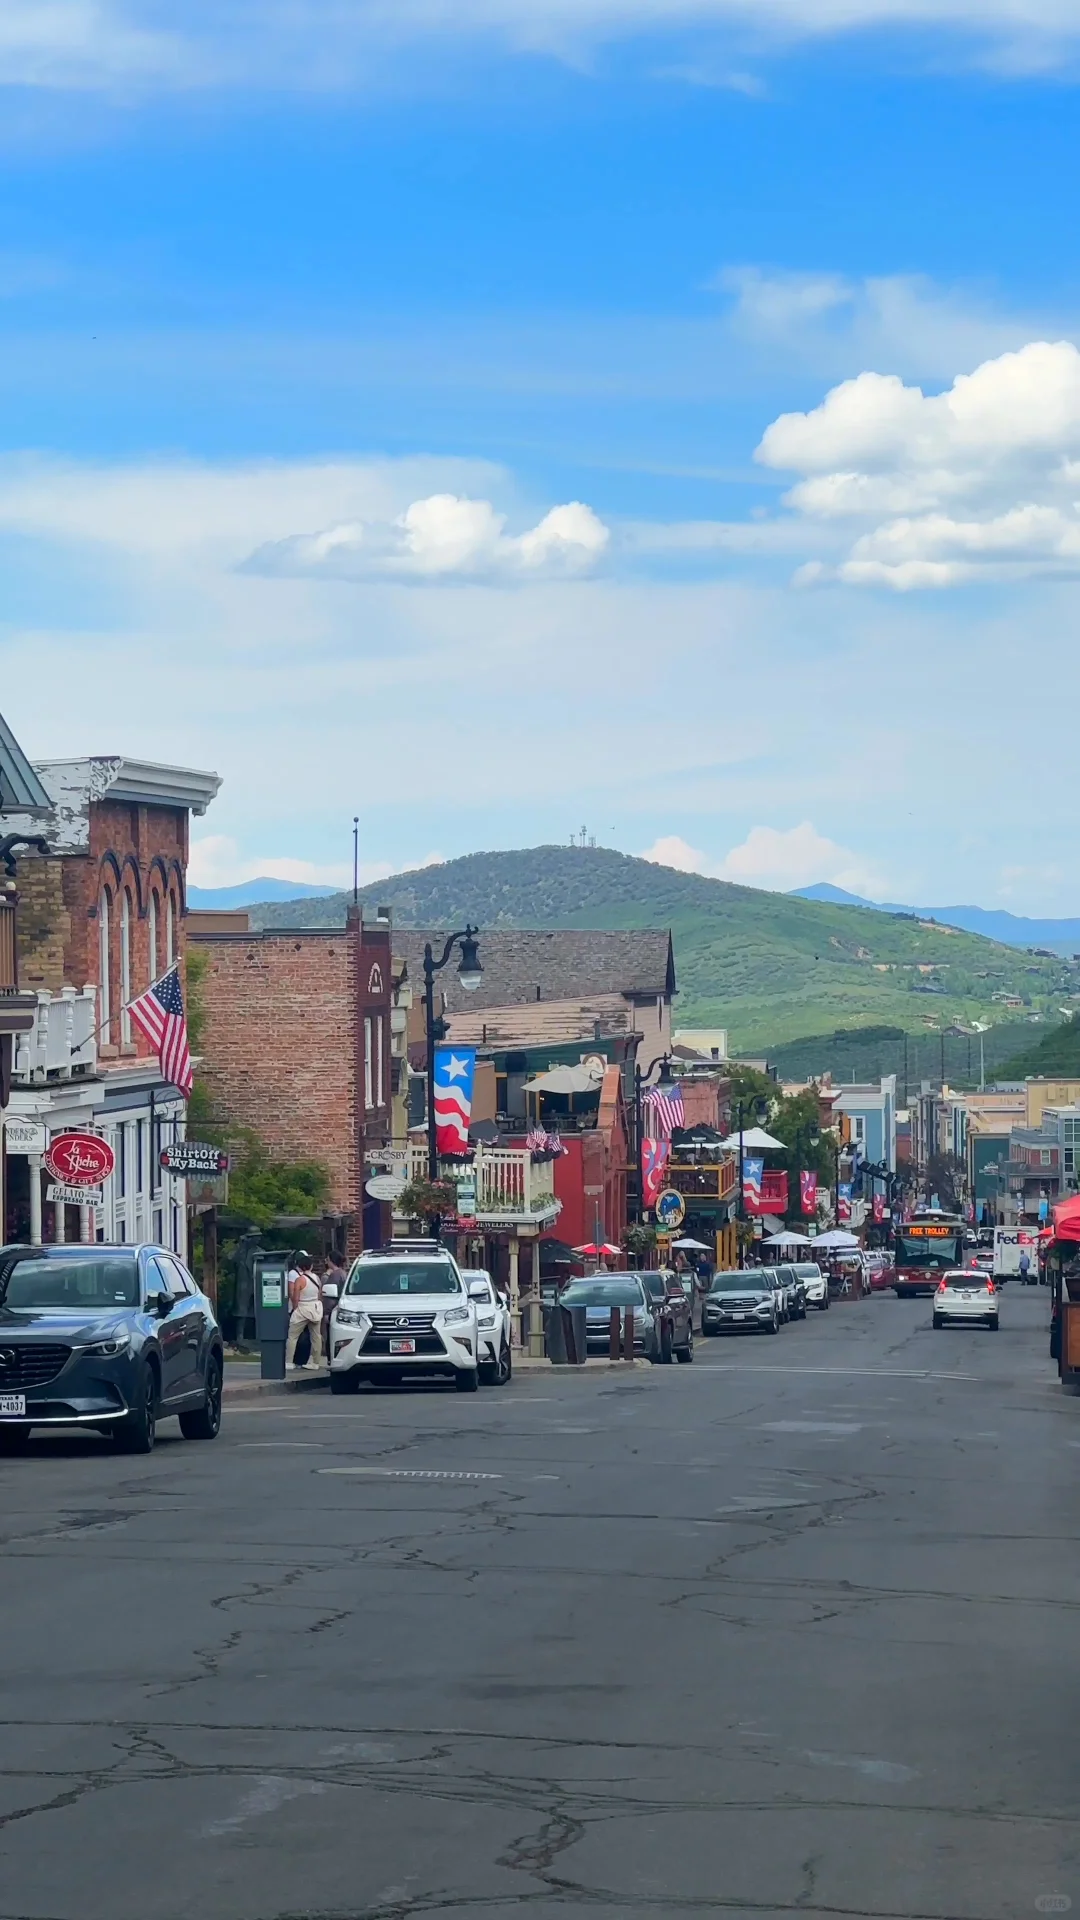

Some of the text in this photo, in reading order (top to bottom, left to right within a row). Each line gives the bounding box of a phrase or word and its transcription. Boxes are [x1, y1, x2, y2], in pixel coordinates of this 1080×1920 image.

[371, 1151, 406, 1160] CROSBY
[53, 1187, 84, 1198] GELATO
[53, 1195, 83, 1204] ESPRESSO
[909, 1227, 949, 1235] FREE TROLLEY
[997, 1232, 1035, 1245] FedEx
